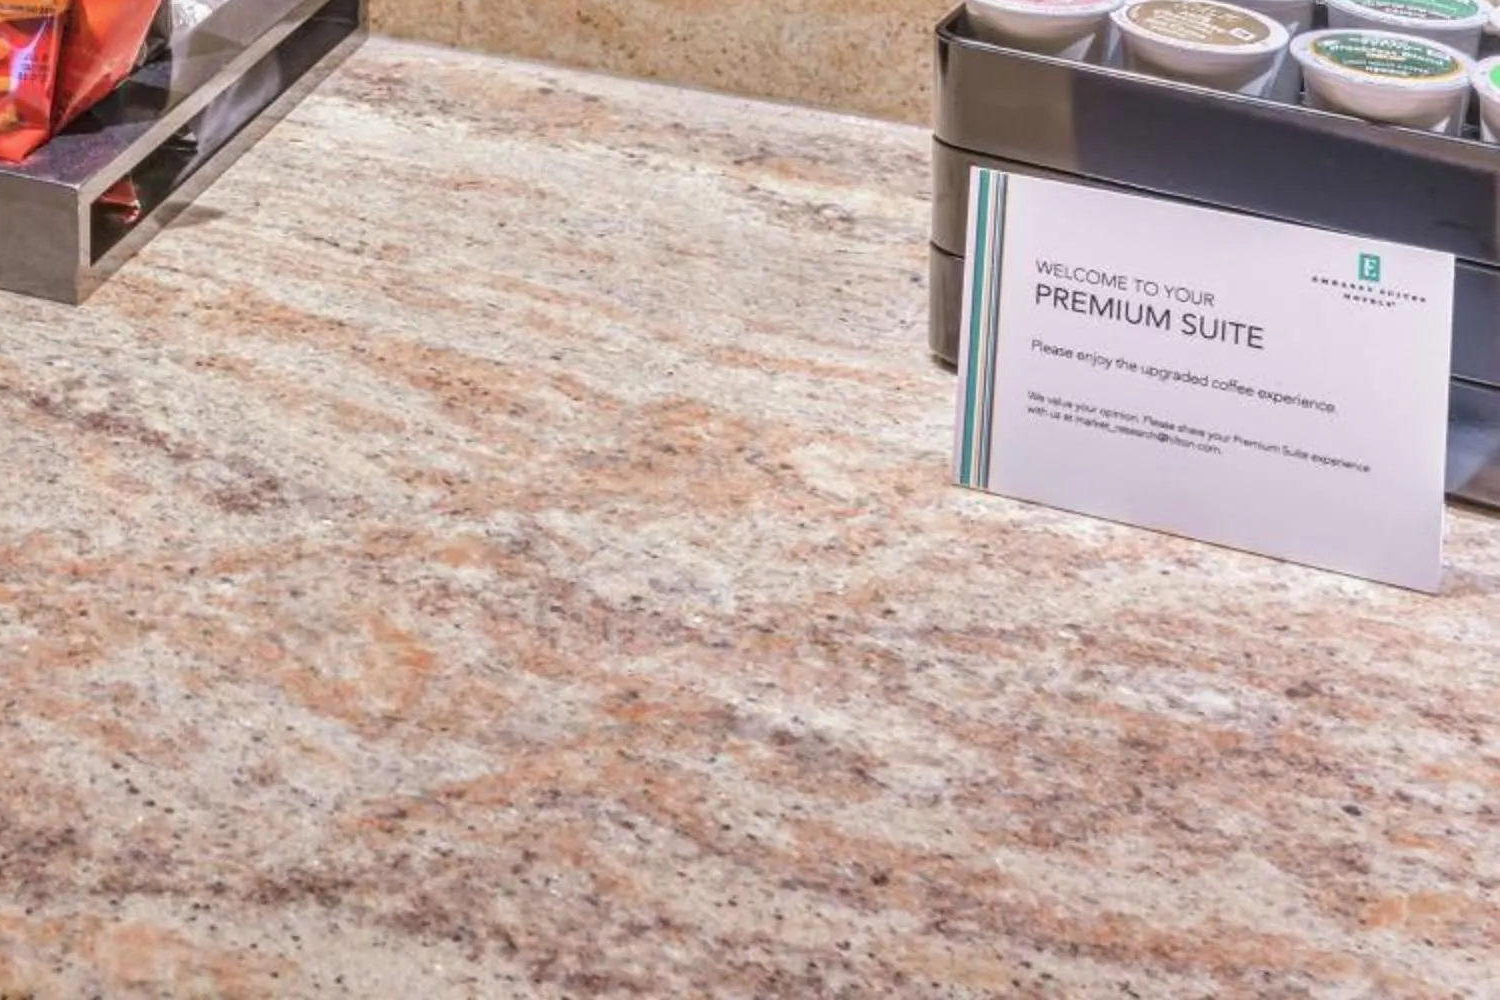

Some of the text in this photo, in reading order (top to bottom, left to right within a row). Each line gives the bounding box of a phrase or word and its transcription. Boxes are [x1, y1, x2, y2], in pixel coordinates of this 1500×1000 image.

[1036, 259, 1215, 307] WELCOME TO YOUR
[1036, 283, 1265, 349] PREMIUM SUITE
[1031, 339, 1073, 358] Please
[1077, 351, 1112, 369] enjoy
[1115, 356, 1137, 372] the
[1140, 364, 1209, 387] upgraded
[1211, 378, 1254, 397] coffee
[1233, 434, 1280, 453] Premium
